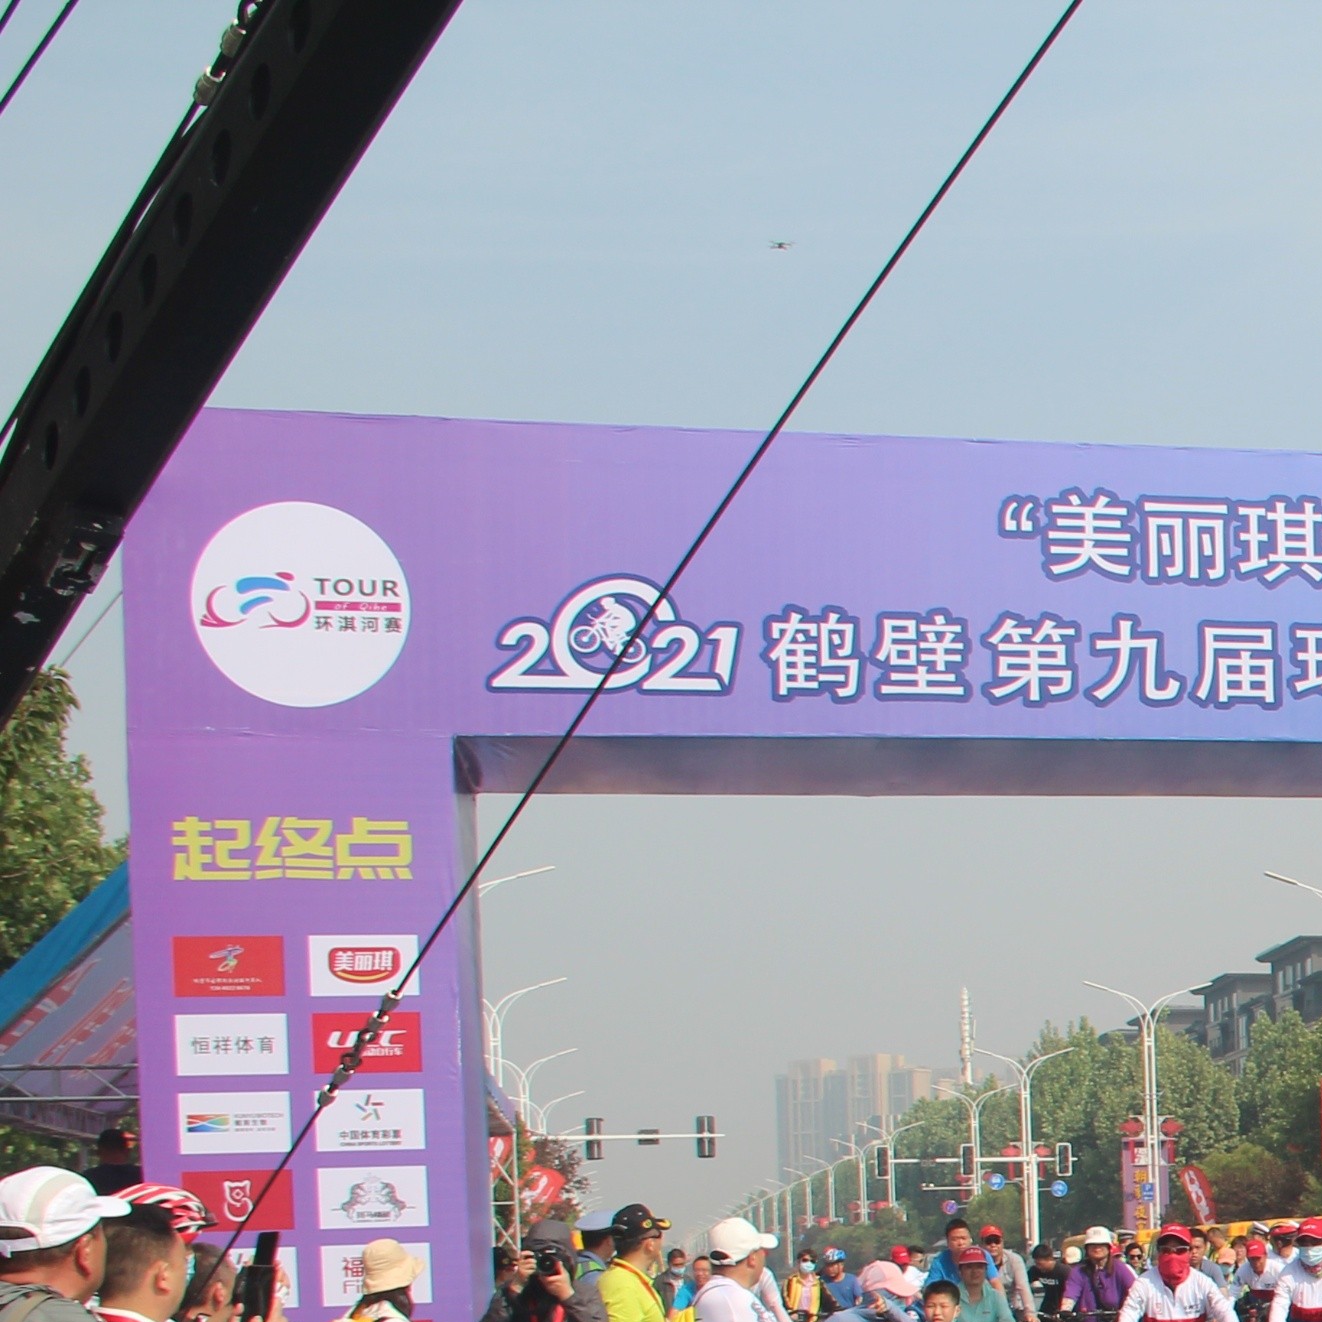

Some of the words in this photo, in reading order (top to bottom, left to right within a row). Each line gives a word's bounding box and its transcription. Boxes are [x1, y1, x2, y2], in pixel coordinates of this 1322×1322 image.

[313, 578, 400, 597] TOUR
[314, 616, 402, 633] 环淇河赛
[172, 816, 413, 881] 起终点
[335, 950, 394, 971] 美丽琪
[191, 1036, 275, 1055] 恒祥体育
[339, 1130, 402, 1140] 中国体育彩票
